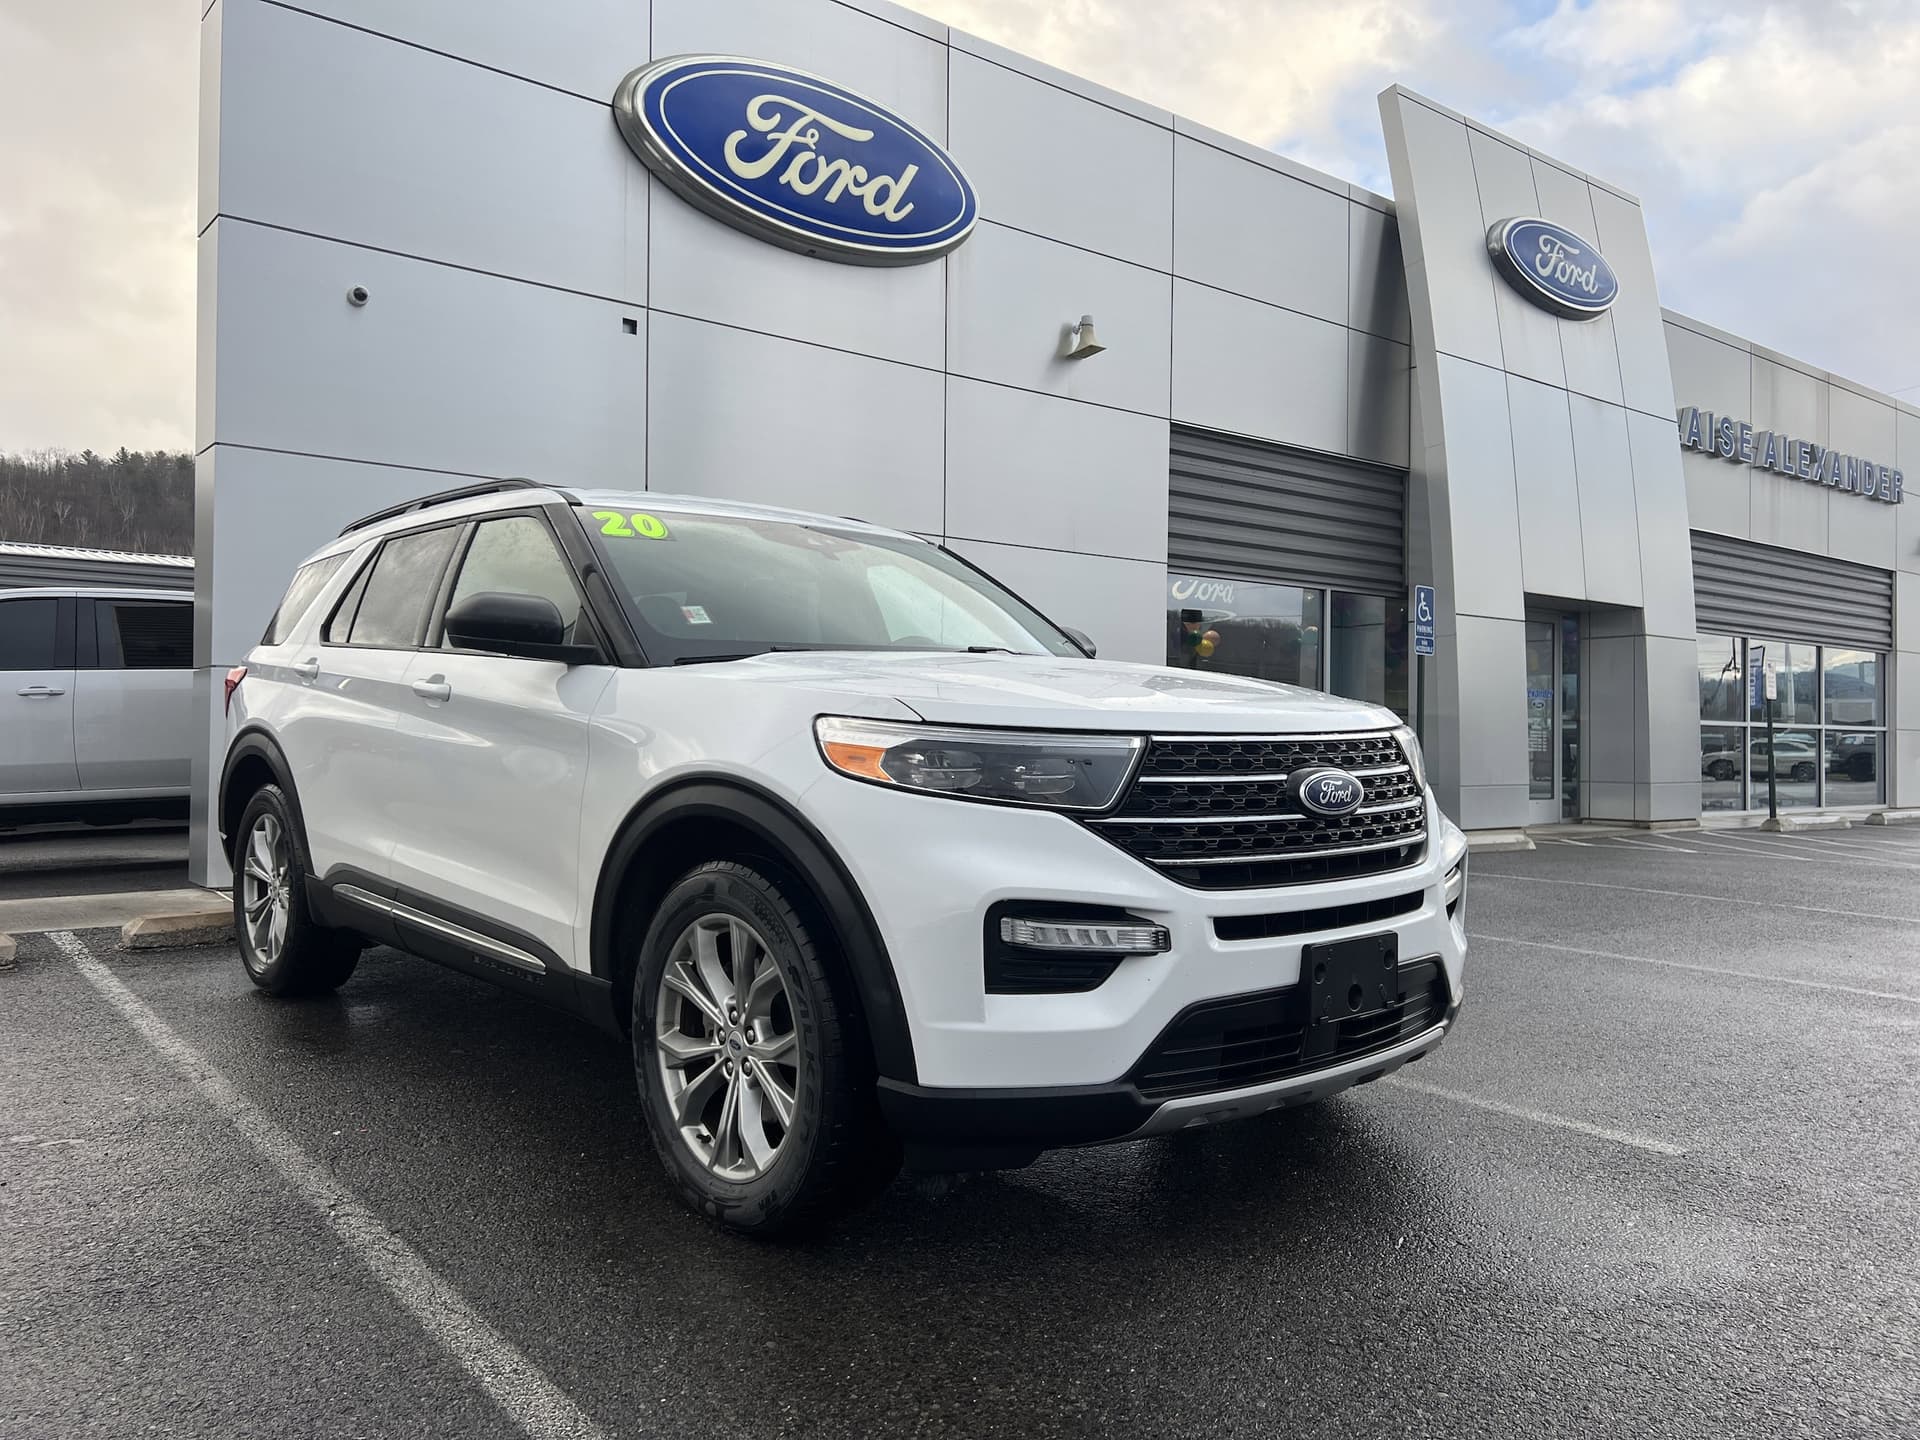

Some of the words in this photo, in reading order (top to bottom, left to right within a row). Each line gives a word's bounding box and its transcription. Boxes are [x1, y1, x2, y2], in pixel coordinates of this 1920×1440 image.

[723, 94, 919, 223] Ford
[1535, 234, 1599, 295] Ford
[1679, 406, 1753, 463] AISE
[1752, 429, 1904, 504] ALEXANDER
[591, 510, 669, 540] 20
[1320, 780, 1353, 804] Ford
